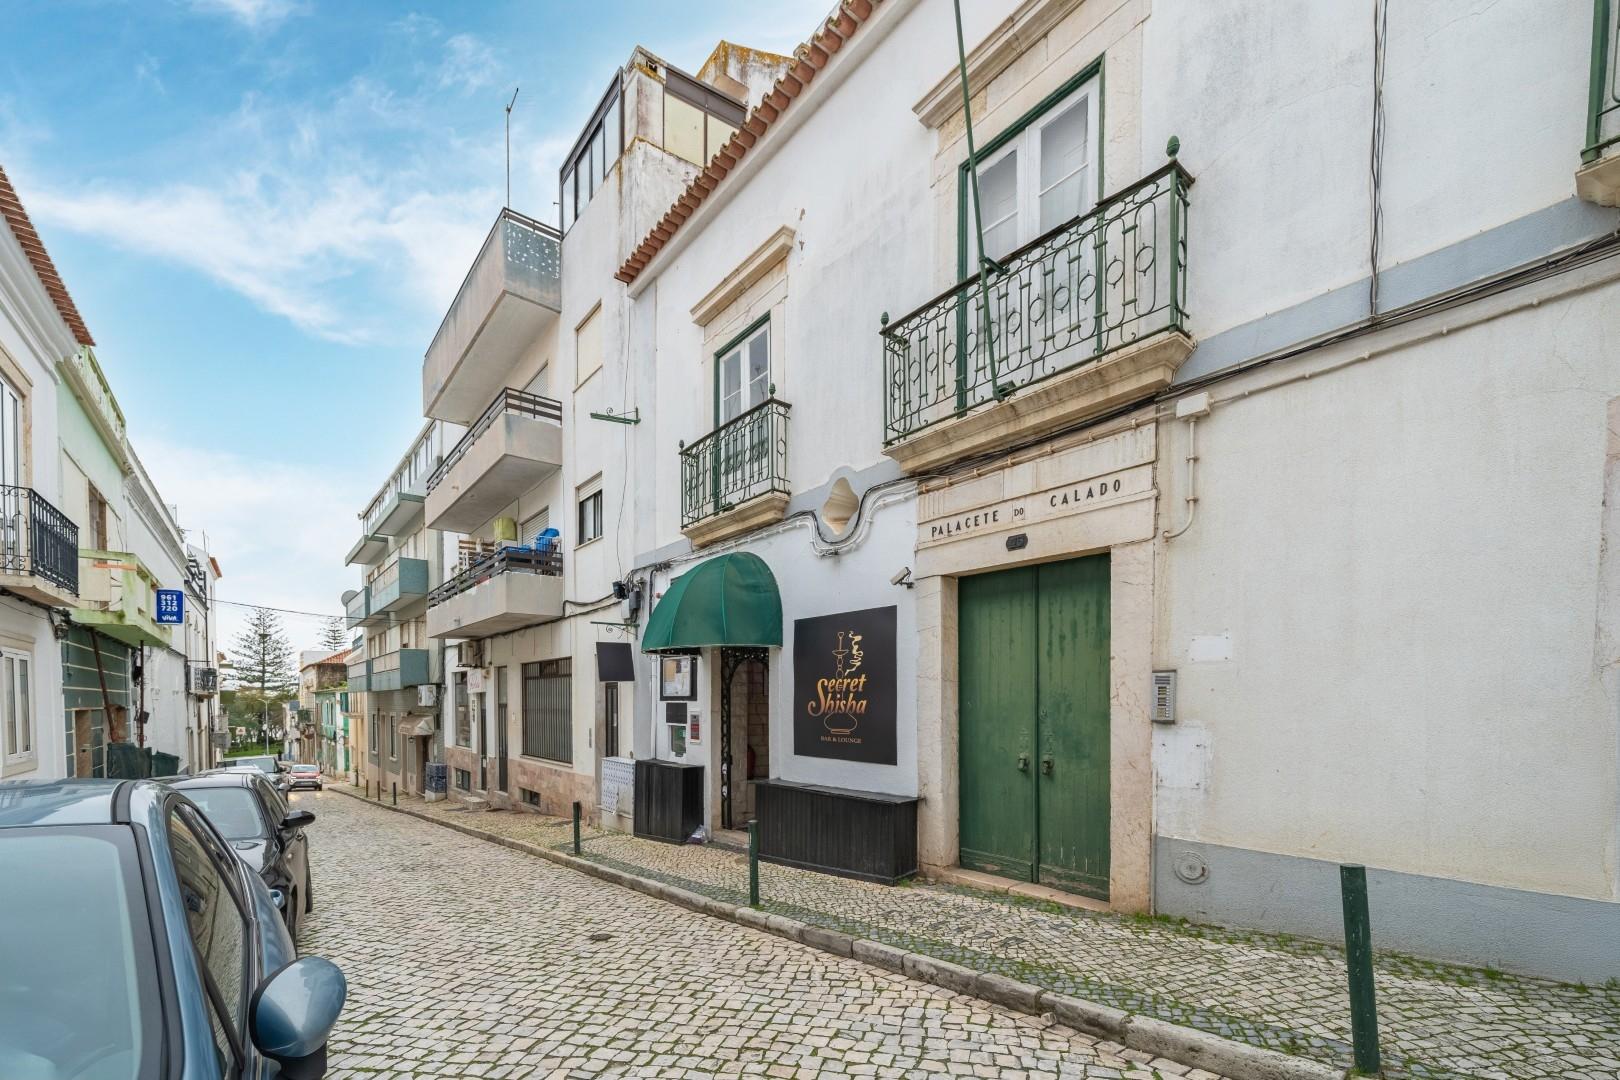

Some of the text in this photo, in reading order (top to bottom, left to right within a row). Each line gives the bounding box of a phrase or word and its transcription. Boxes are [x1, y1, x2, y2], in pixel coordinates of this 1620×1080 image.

[931, 479, 1121, 538] PALACETE DO CALADO
[817, 674, 867, 694] Secret
[807, 693, 868, 717] Shisha
[837, 736, 862, 744] LOUNGE
